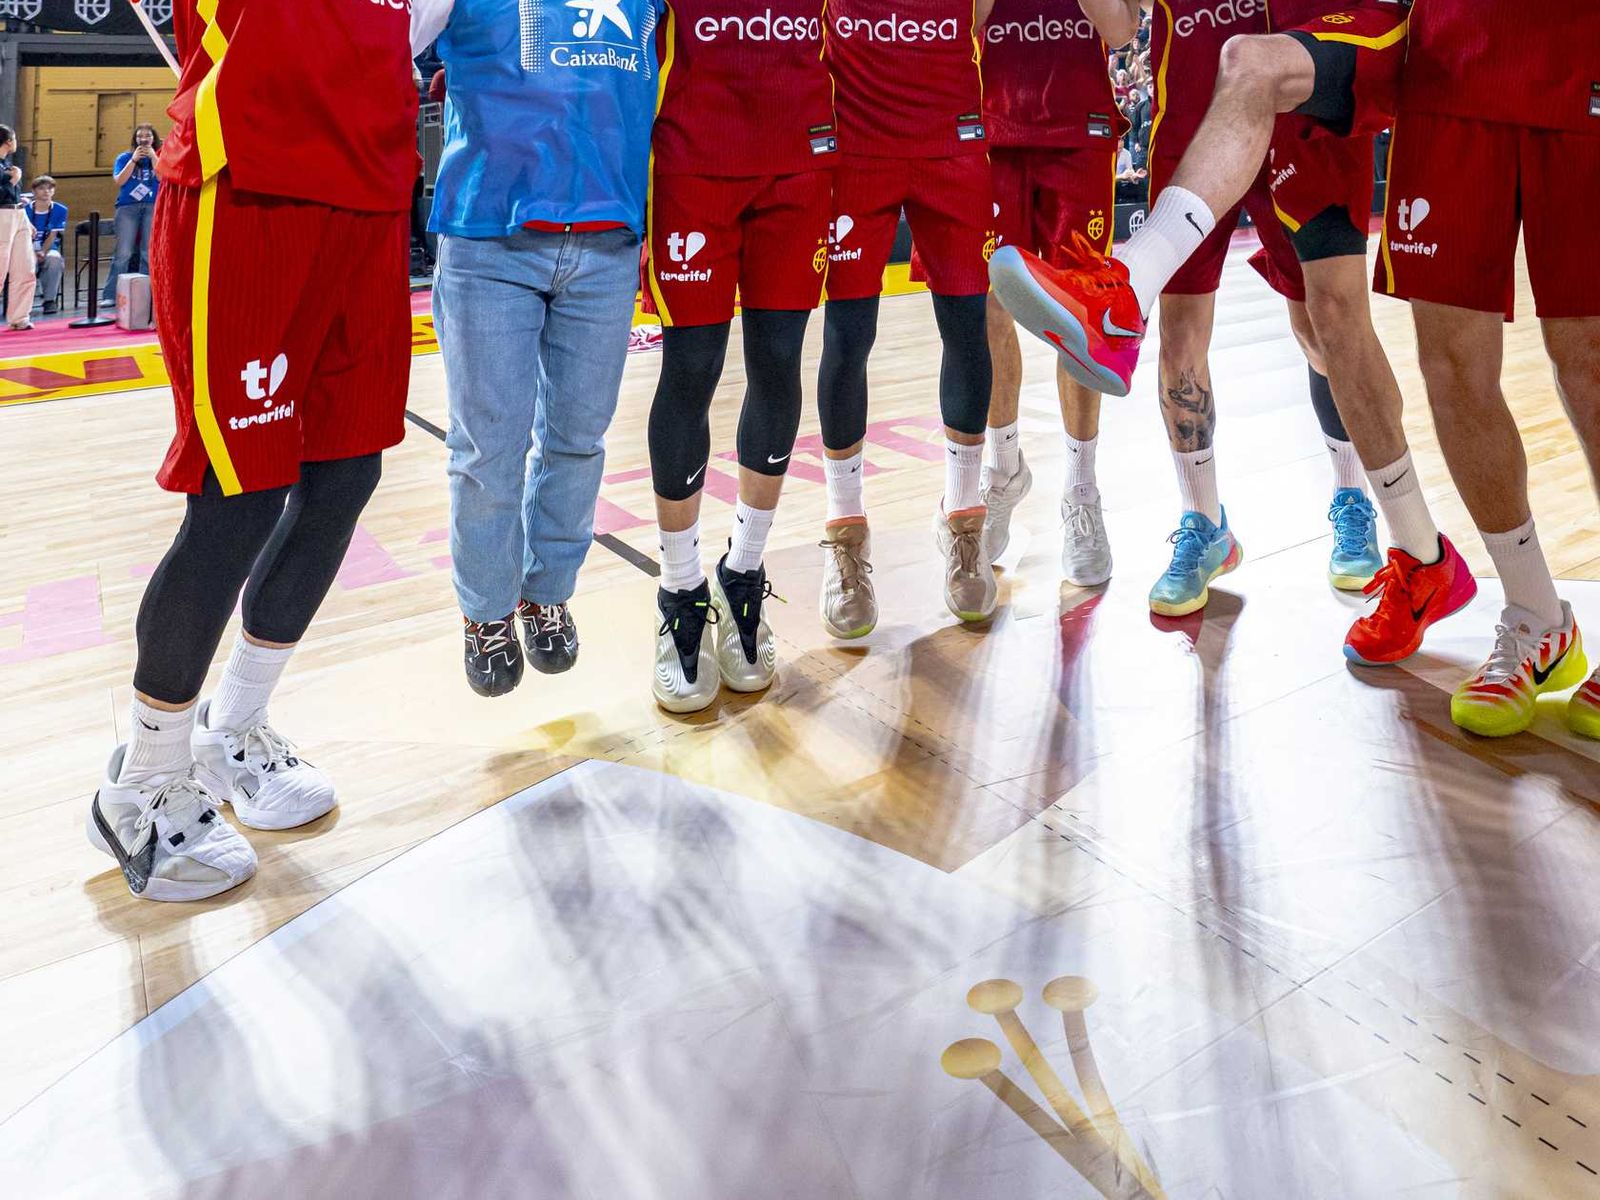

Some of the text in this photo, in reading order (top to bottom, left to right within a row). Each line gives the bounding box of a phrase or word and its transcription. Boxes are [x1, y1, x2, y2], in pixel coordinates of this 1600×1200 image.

[695, 8, 819, 41] endesa
[836, 13, 957, 42] endesa
[987, 15, 1094, 43] endesa
[550, 47, 640, 73] CaixaBank
